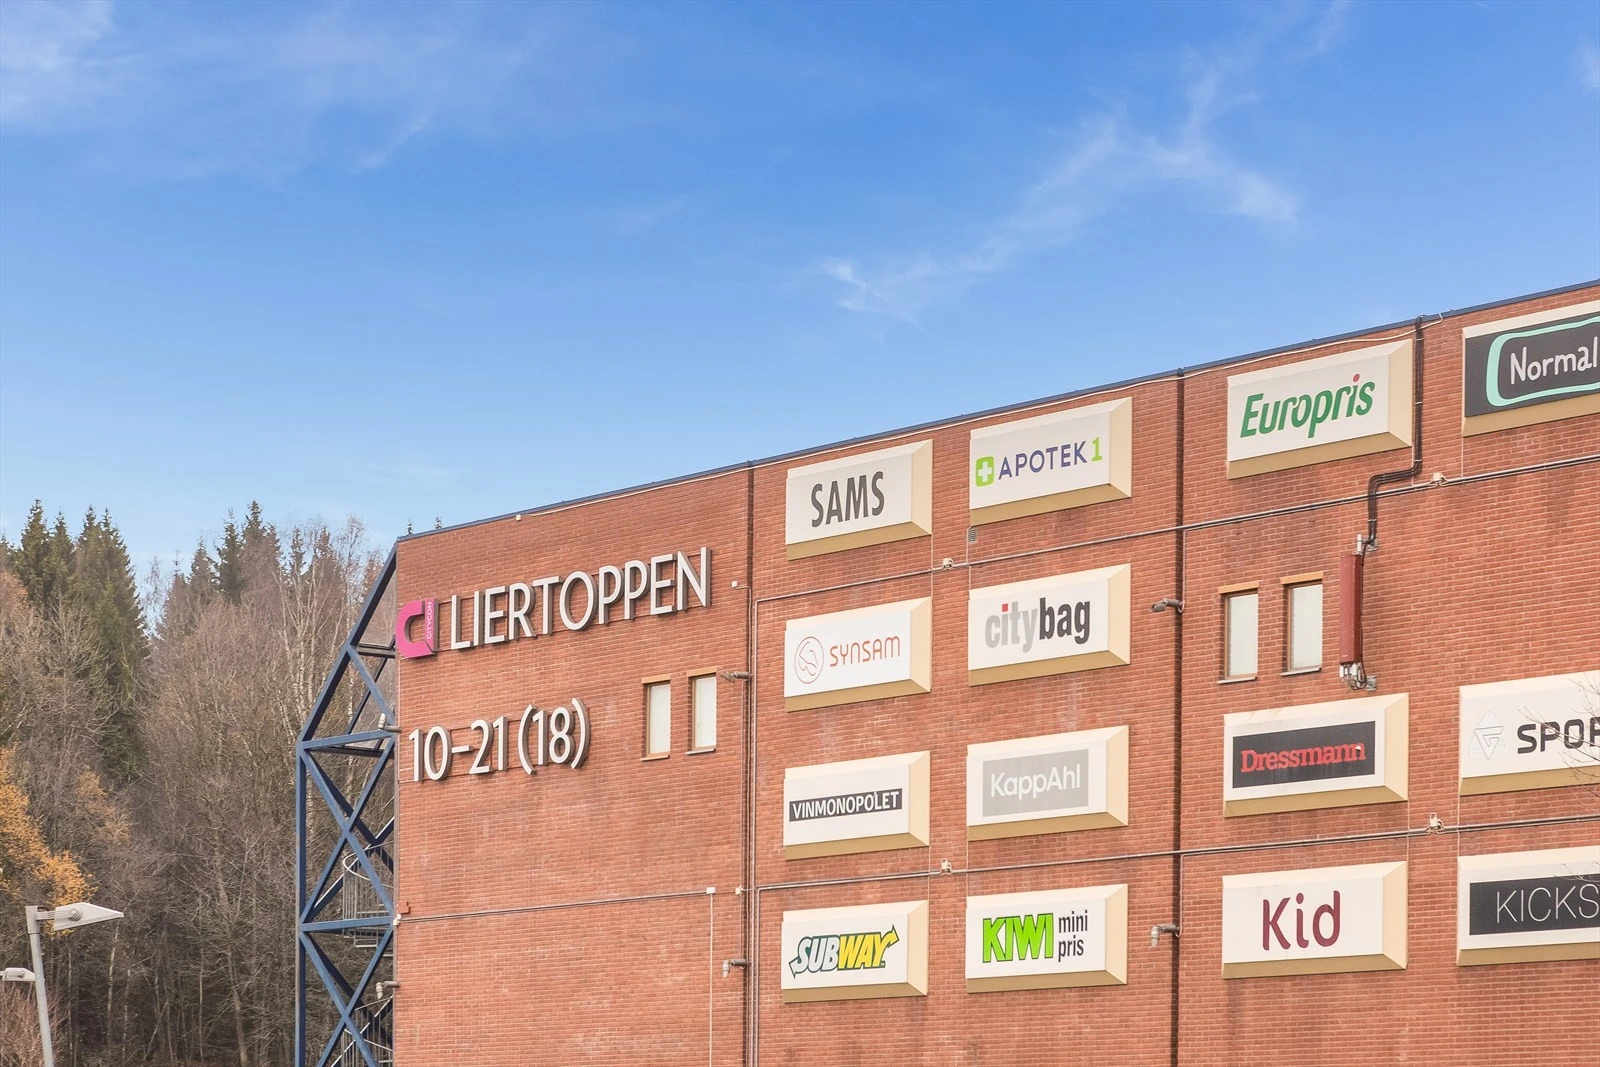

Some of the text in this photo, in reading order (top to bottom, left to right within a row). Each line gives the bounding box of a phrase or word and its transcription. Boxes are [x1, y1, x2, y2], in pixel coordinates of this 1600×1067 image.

[1510, 336, 1599, 385] Normal
[1240, 373, 1375, 438] Europris
[998, 437, 1103, 480] APOTEK 1
[811, 471, 885, 527] SAMS
[451, 547, 711, 650] LIERTOPPEN
[829, 635, 901, 667] SYNSAM
[409, 698, 589, 783] 10-21 (18)
[1241, 742, 1366, 773] Dressmann
[792, 790, 900, 820] VINMONOPOLET
[990, 764, 1081, 800] KappAhl
[1262, 890, 1341, 950] Kid
[1496, 883, 1599, 924] KICKS
[789, 925, 899, 978] SUBWAY
[982, 910, 1088, 963] KIWI mini
[1058, 936, 1084, 962] pris
